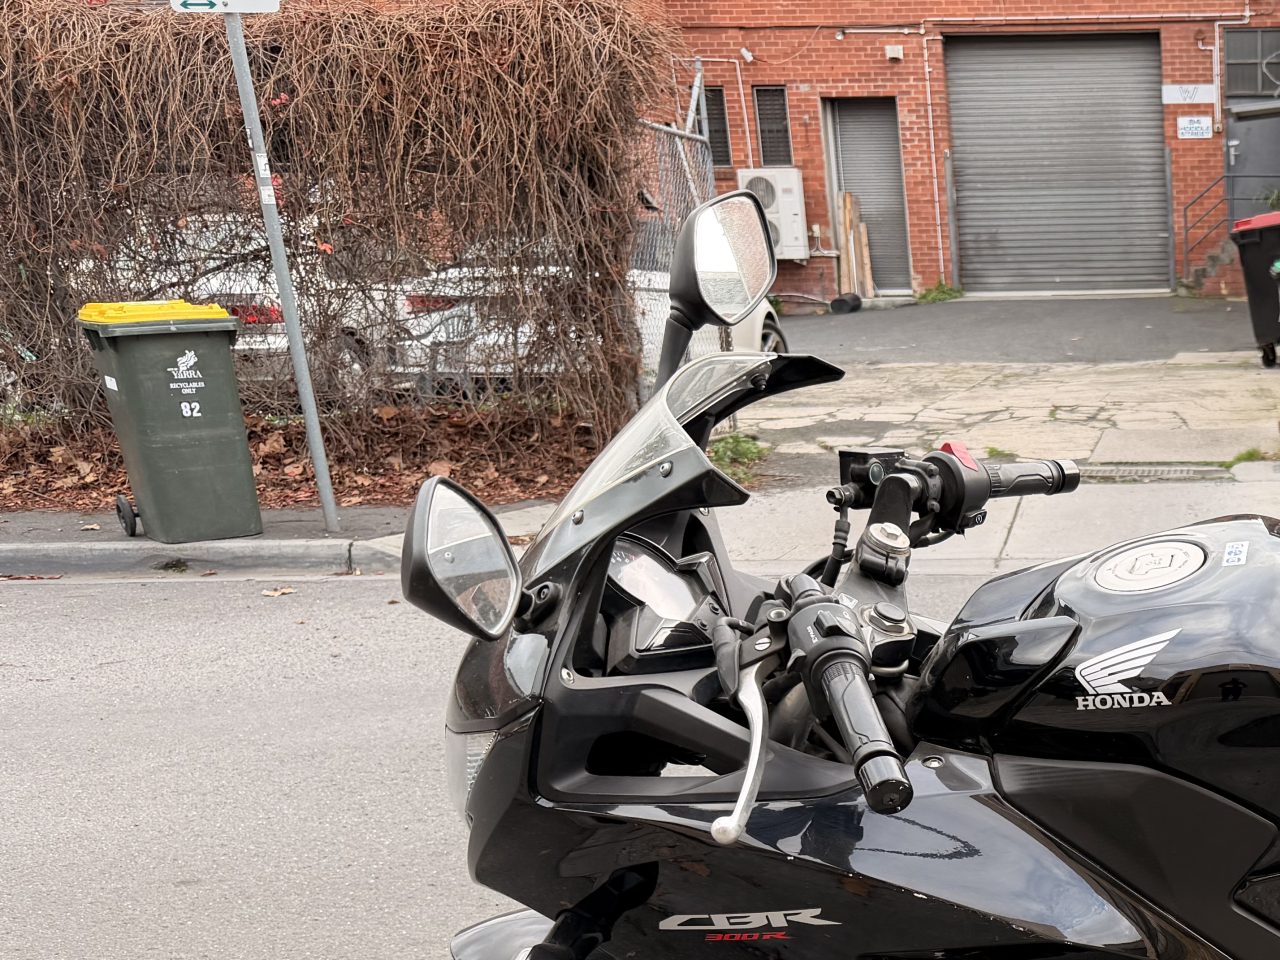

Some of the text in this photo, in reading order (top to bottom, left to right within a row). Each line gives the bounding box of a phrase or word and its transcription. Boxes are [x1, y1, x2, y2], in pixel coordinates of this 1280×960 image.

[172, 370, 202, 378] YARRA
[181, 402, 201, 416] 82
[1075, 691, 1172, 711] HONDA
[658, 907, 843, 931] CBR
[705, 931, 792, 940] 300R
